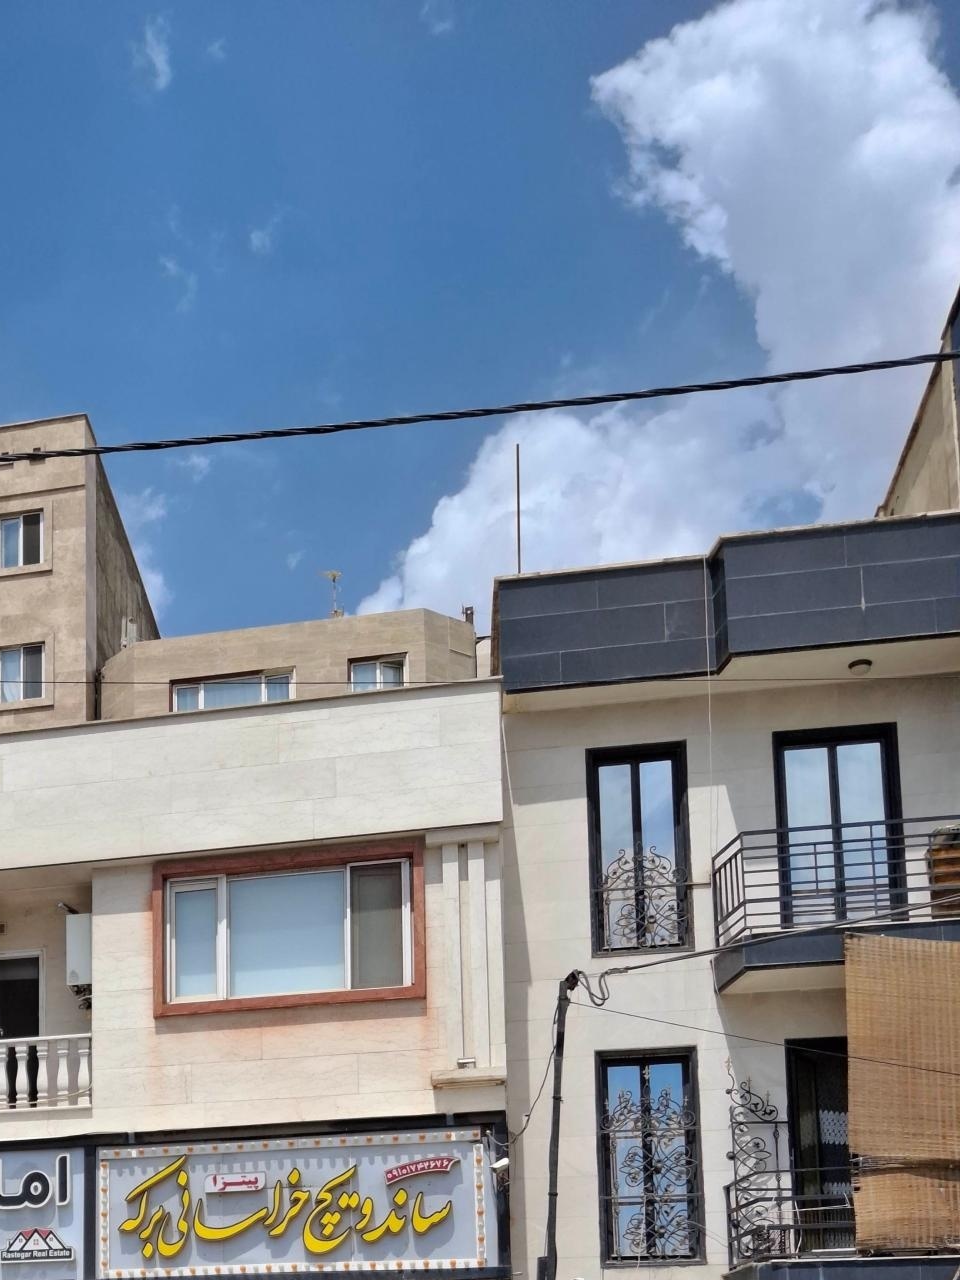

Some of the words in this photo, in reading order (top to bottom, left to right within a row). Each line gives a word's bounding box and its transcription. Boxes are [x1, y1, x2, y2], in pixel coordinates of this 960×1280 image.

[118, 1155, 187, 1259] برکه
[157, 1168, 311, 1257] خراسانی
[213, 1174, 259, 1191] پیتزا
[303, 1165, 453, 1254] ساندویچ
[2, 1252, 31, 1260] Rastegar
